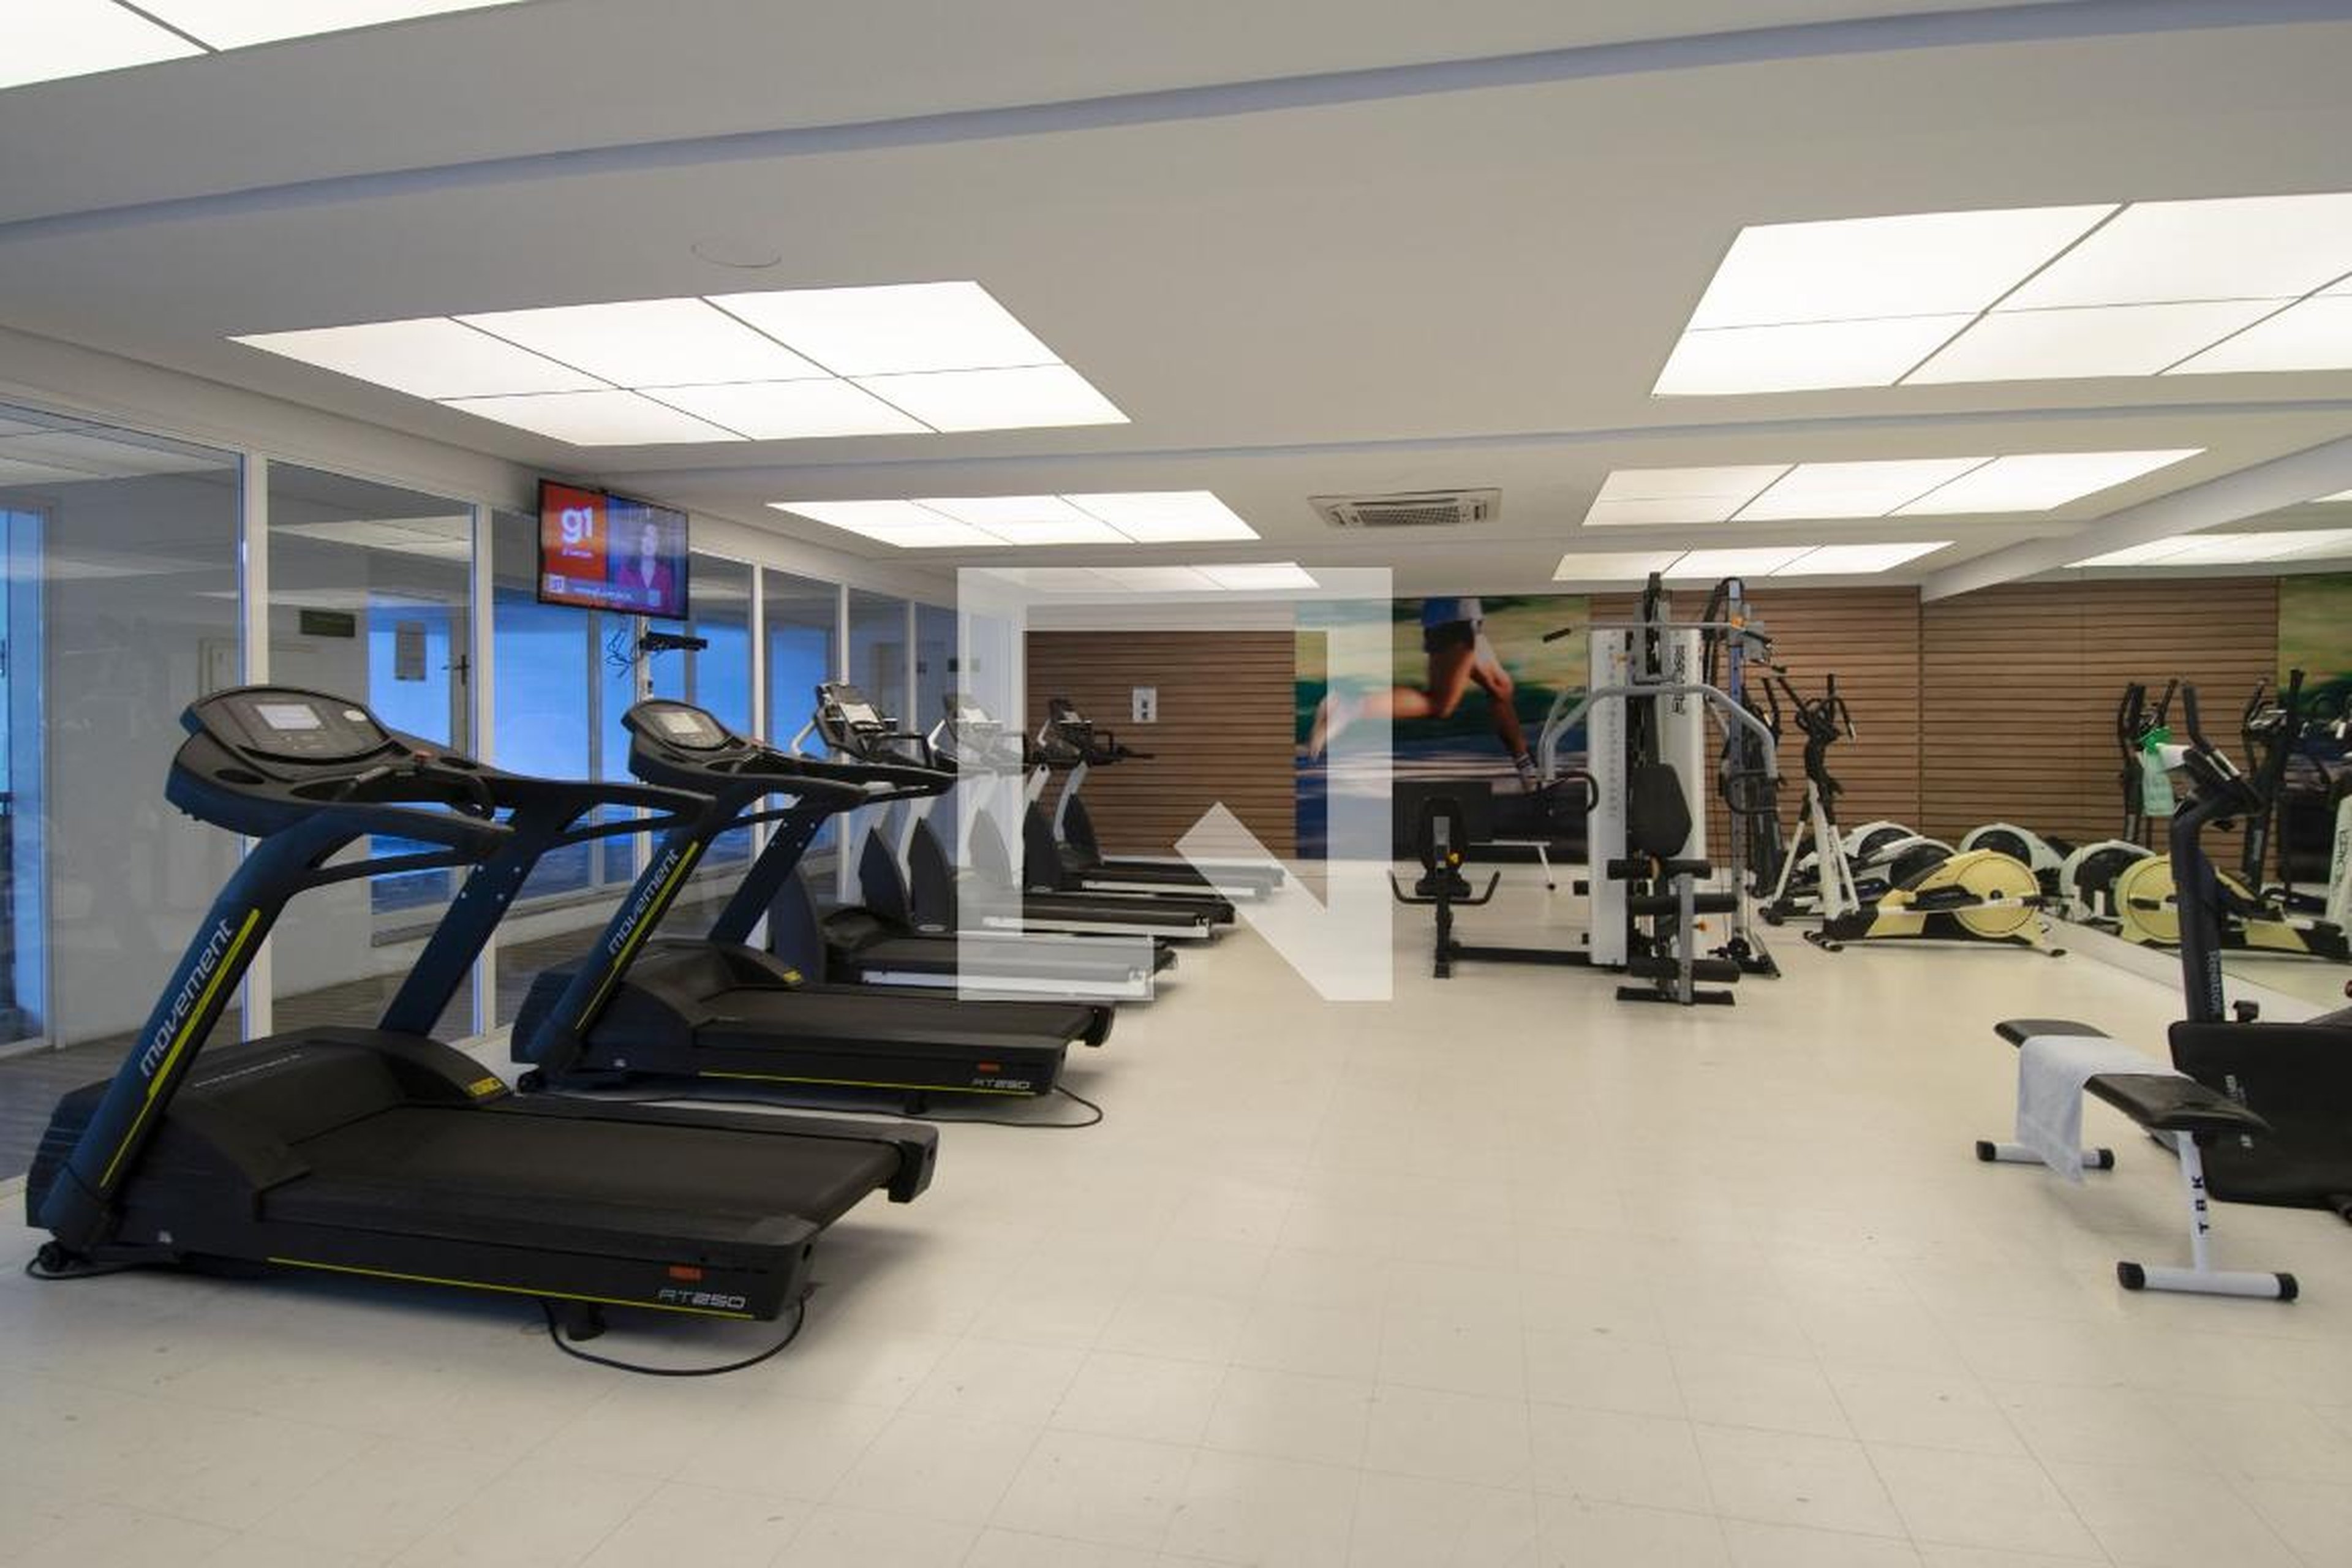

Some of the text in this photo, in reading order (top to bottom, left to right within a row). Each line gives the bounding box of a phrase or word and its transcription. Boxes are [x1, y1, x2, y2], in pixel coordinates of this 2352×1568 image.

[562, 507, 593, 544] g1
[607, 848, 680, 956] movement
[139, 918, 233, 1077] movement
